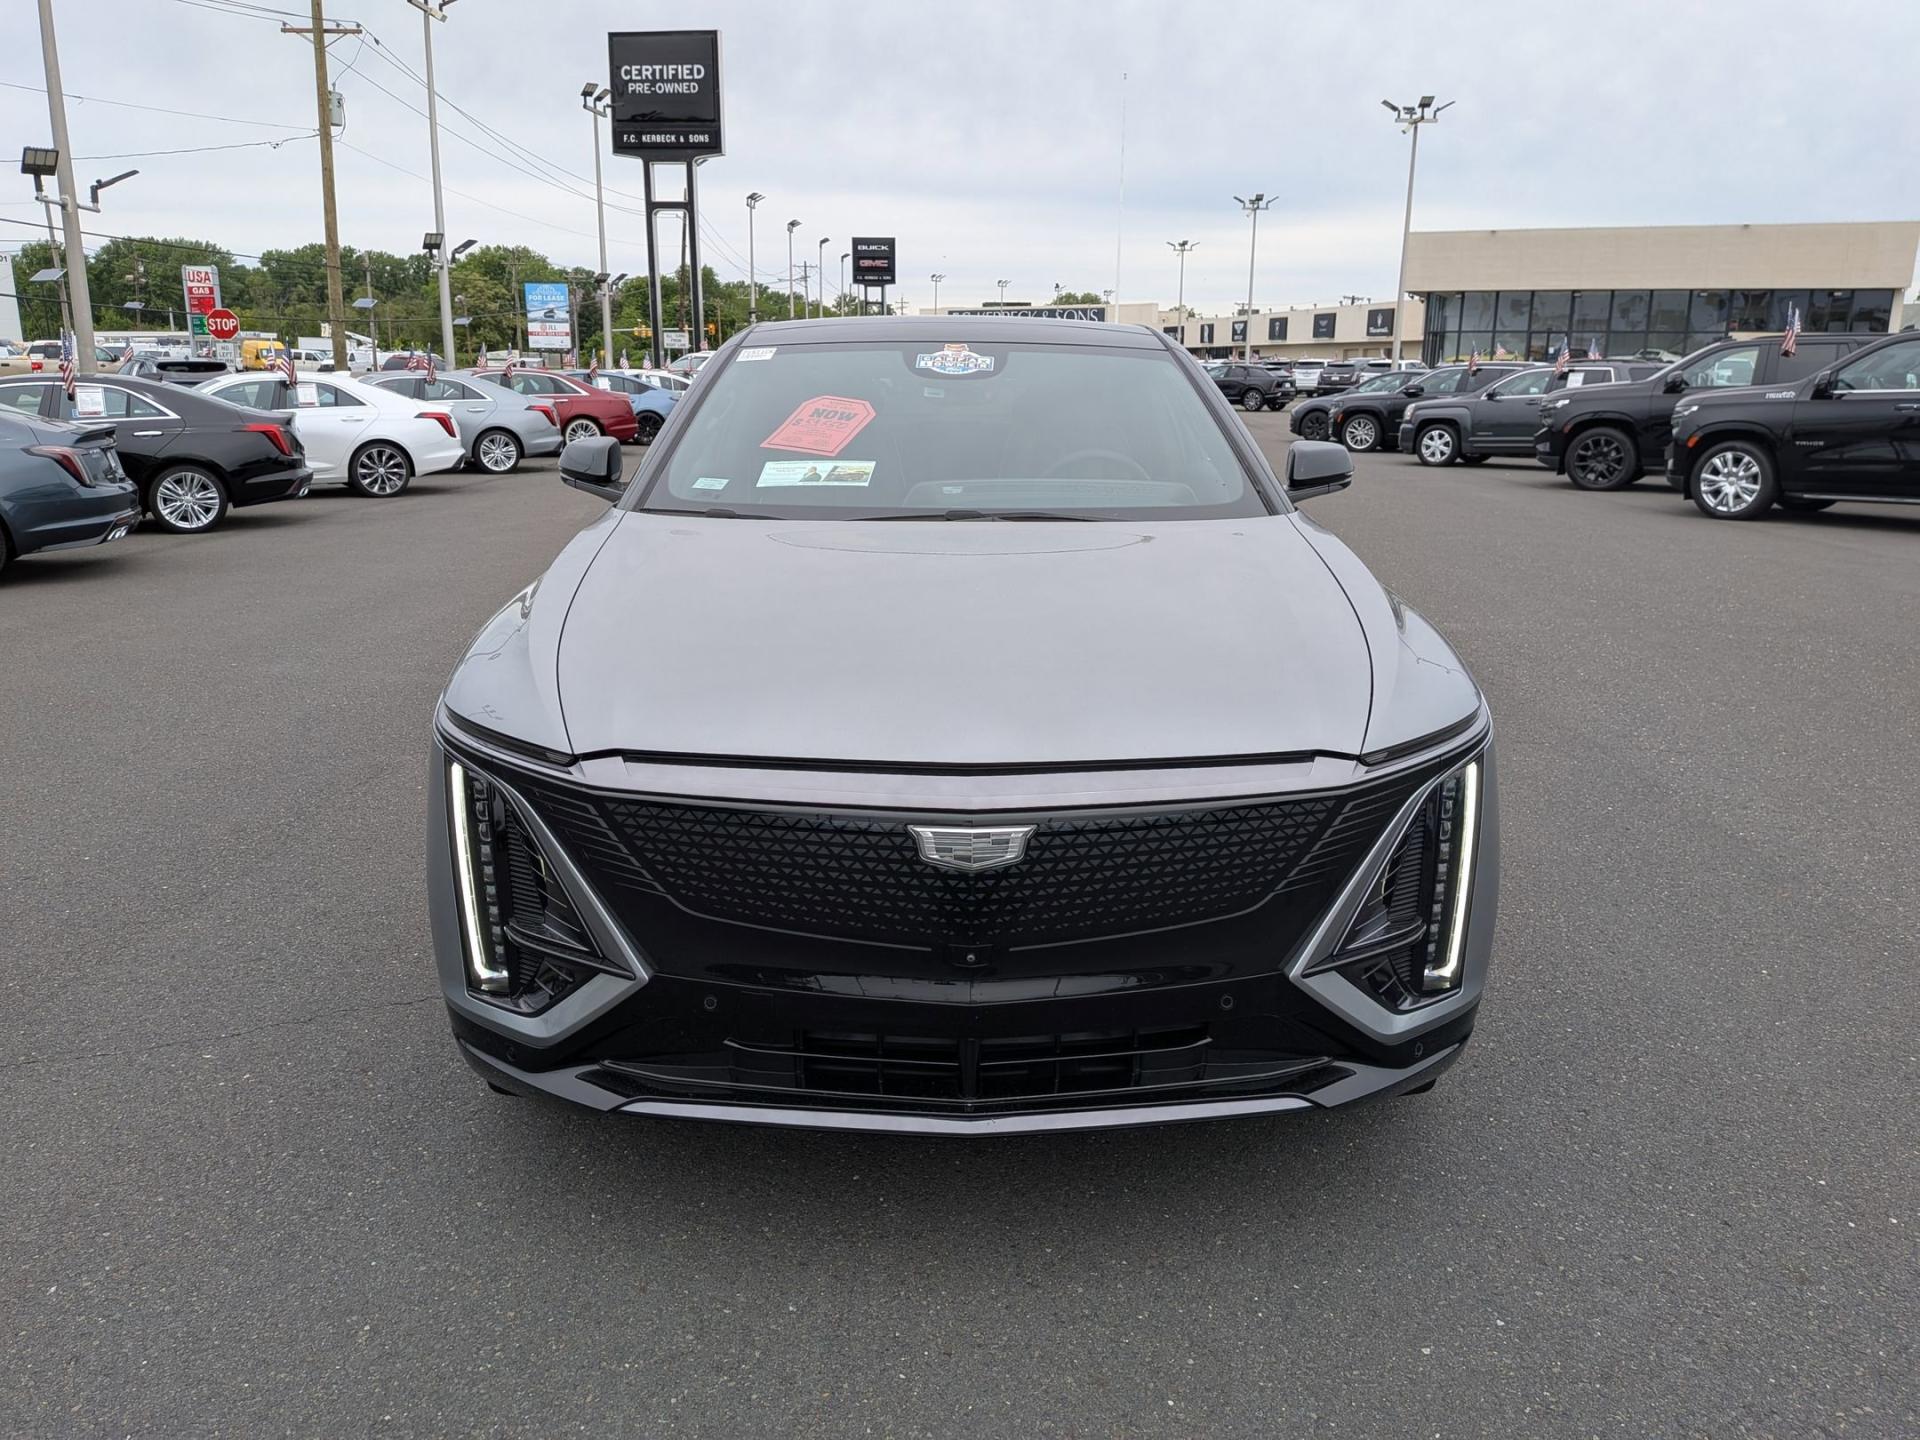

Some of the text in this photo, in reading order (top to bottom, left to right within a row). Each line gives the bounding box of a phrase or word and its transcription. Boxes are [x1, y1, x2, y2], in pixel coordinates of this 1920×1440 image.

[620, 64, 705, 80] CERTIFIED
[628, 82, 699, 94] PRE-OWNED
[623, 134, 638, 142] F.C.
[642, 134, 677, 142] KERBECK
[688, 134, 709, 142] SONS
[859, 259, 889, 267] GMC
[187, 270, 212, 283] USA
[208, 318, 237, 331] STOP
[810, 407, 859, 421] NOW
